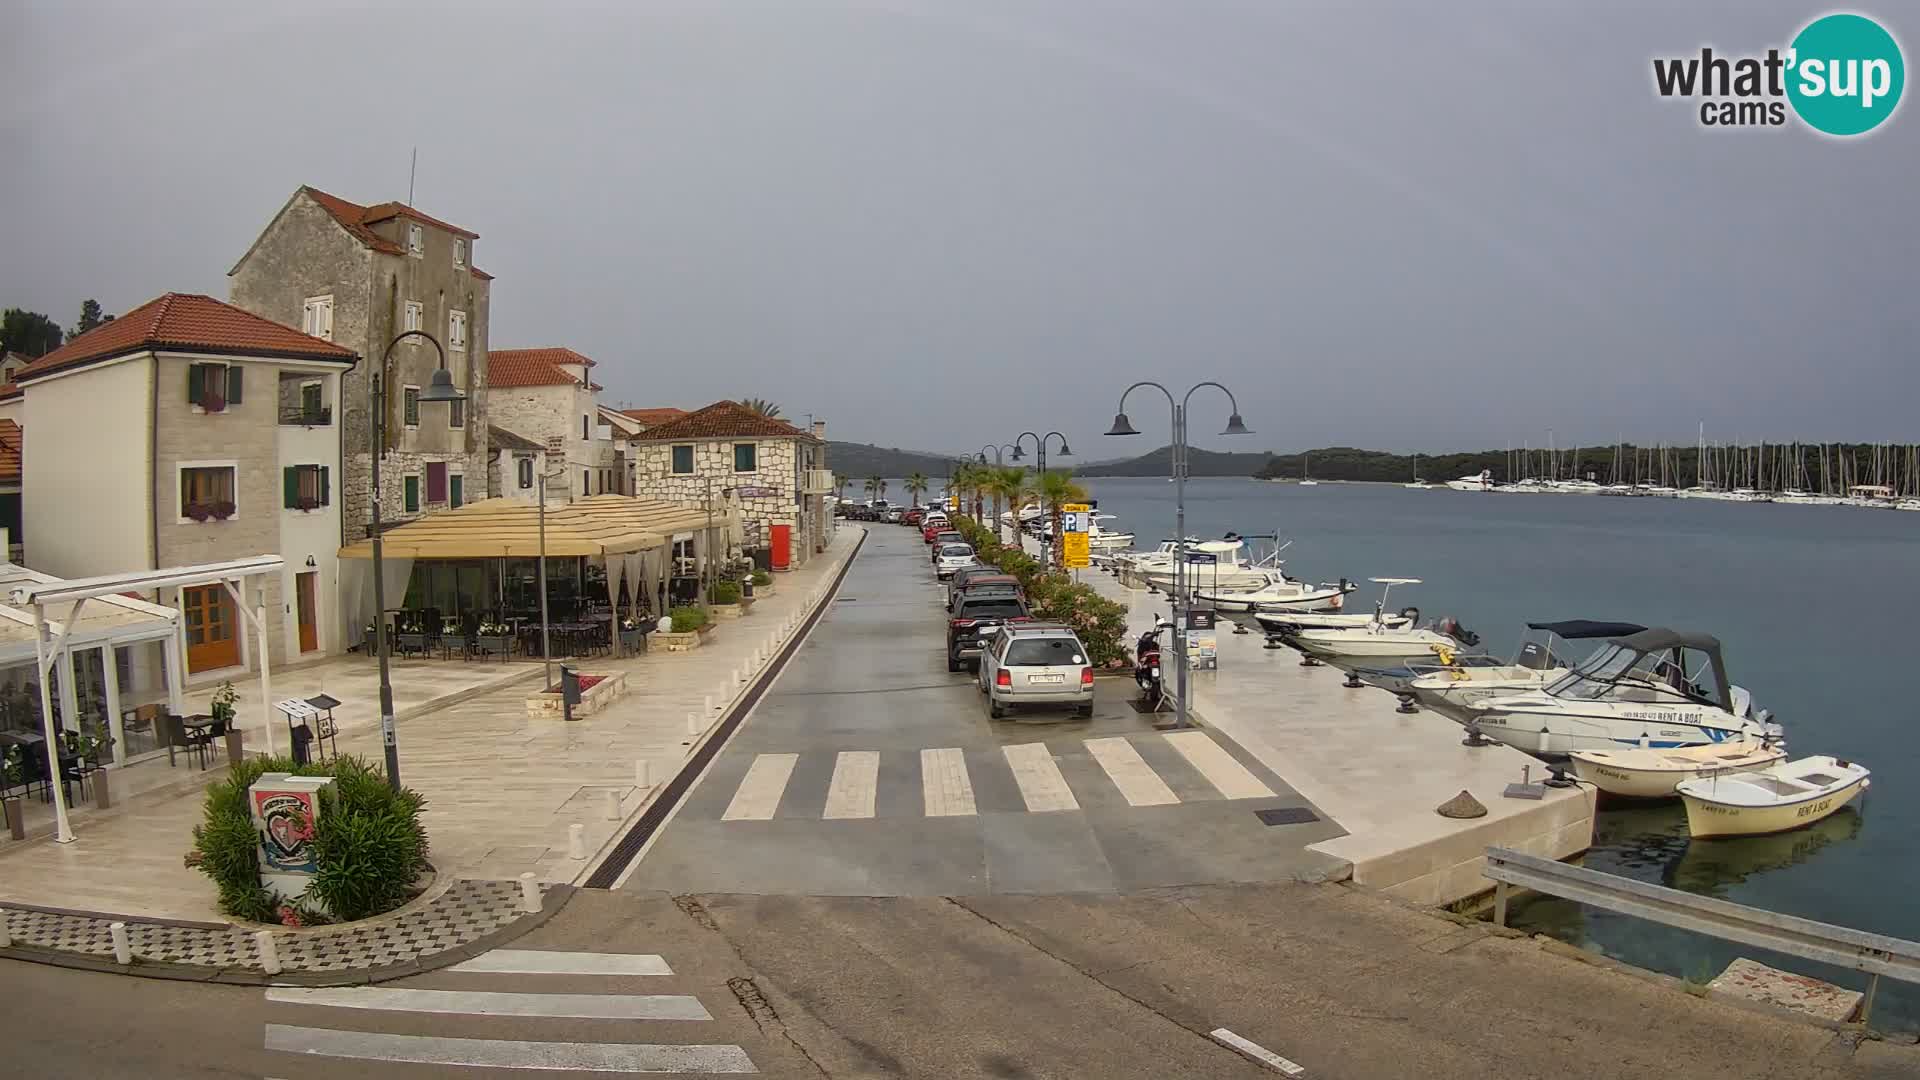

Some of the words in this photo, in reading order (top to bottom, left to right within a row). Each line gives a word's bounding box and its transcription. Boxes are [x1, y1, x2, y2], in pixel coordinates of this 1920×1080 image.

[1065, 514, 1076, 530] P
[1657, 712, 1677, 721] RENT
[1684, 713, 1703, 724] BOAT
[1797, 804, 1813, 816] RENT
[1817, 799, 1832, 812] BOAT
